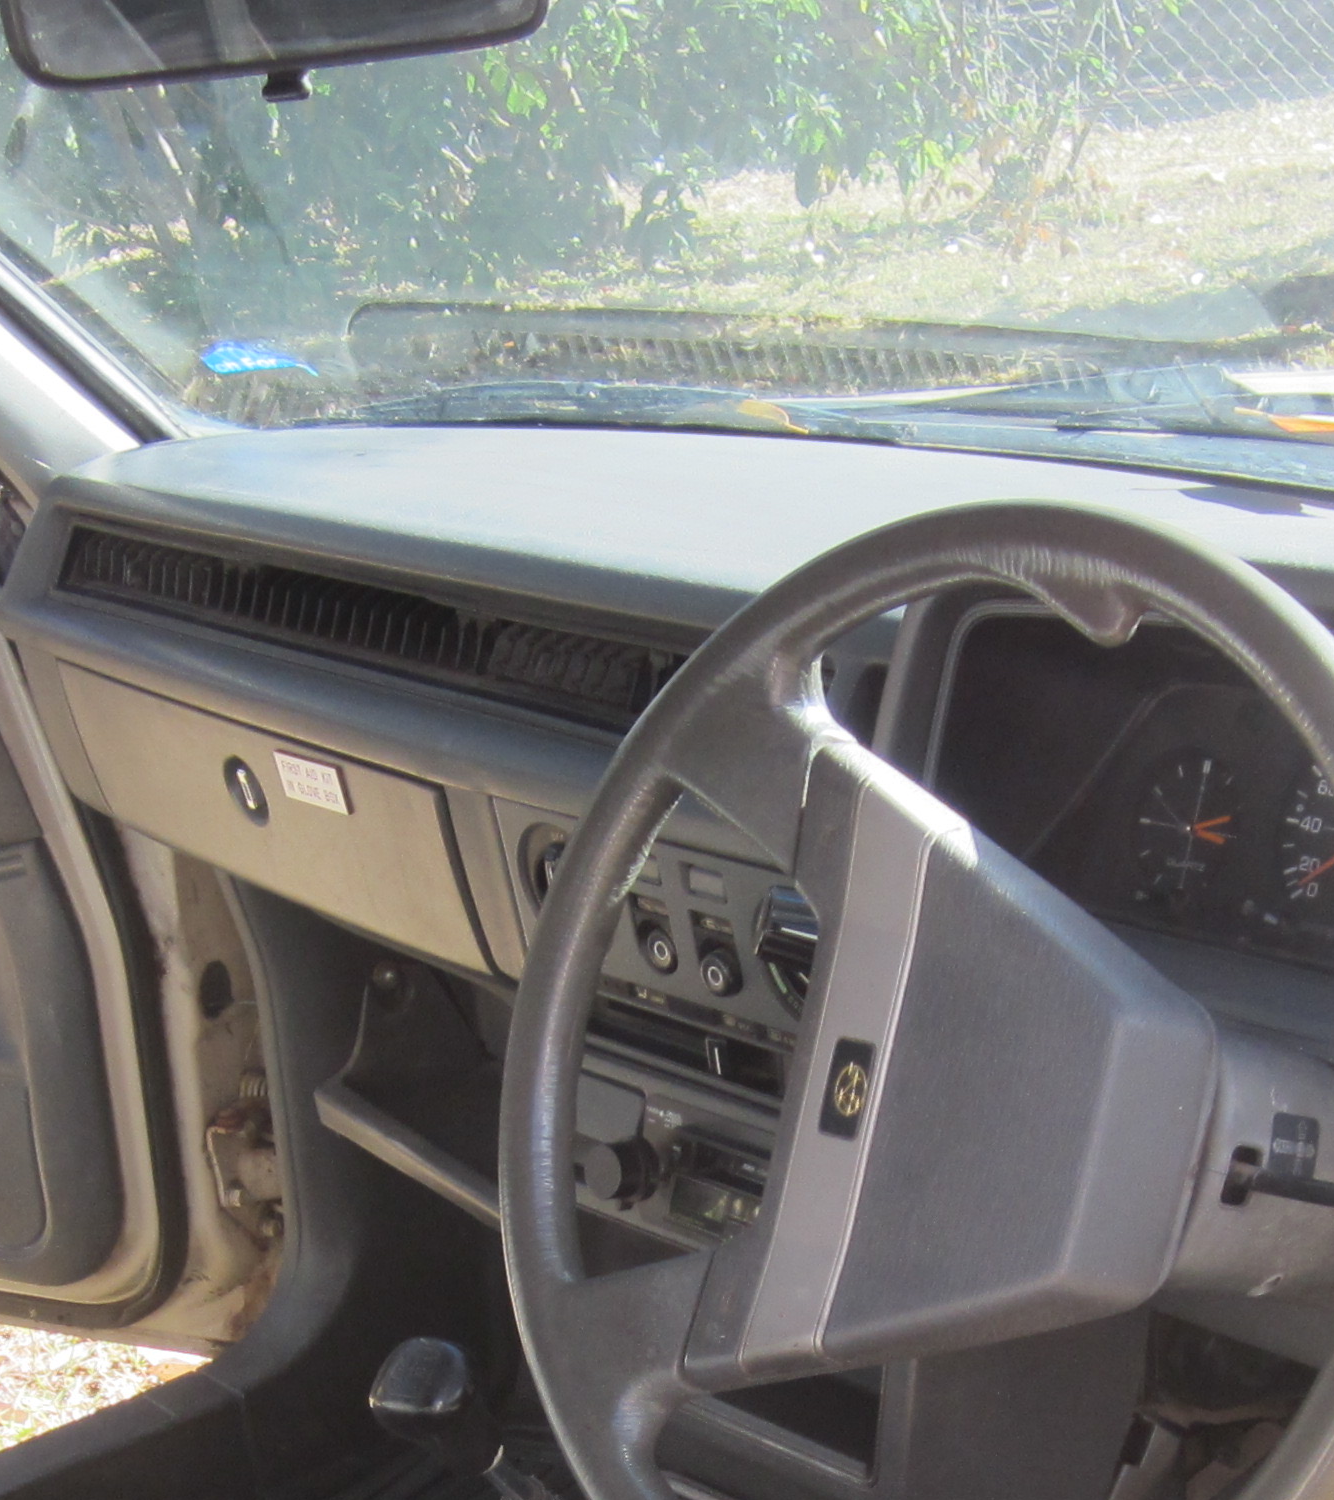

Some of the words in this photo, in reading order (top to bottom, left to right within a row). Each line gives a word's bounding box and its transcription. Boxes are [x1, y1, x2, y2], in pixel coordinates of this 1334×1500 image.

[280, 760, 302, 776] FIRST
[305, 767, 319, 781] AID
[321, 772, 334, 786] KIT
[1299, 815, 1322, 833] 40
[1299, 855, 1320, 873] 20
[1306, 882, 1318, 898] 0
